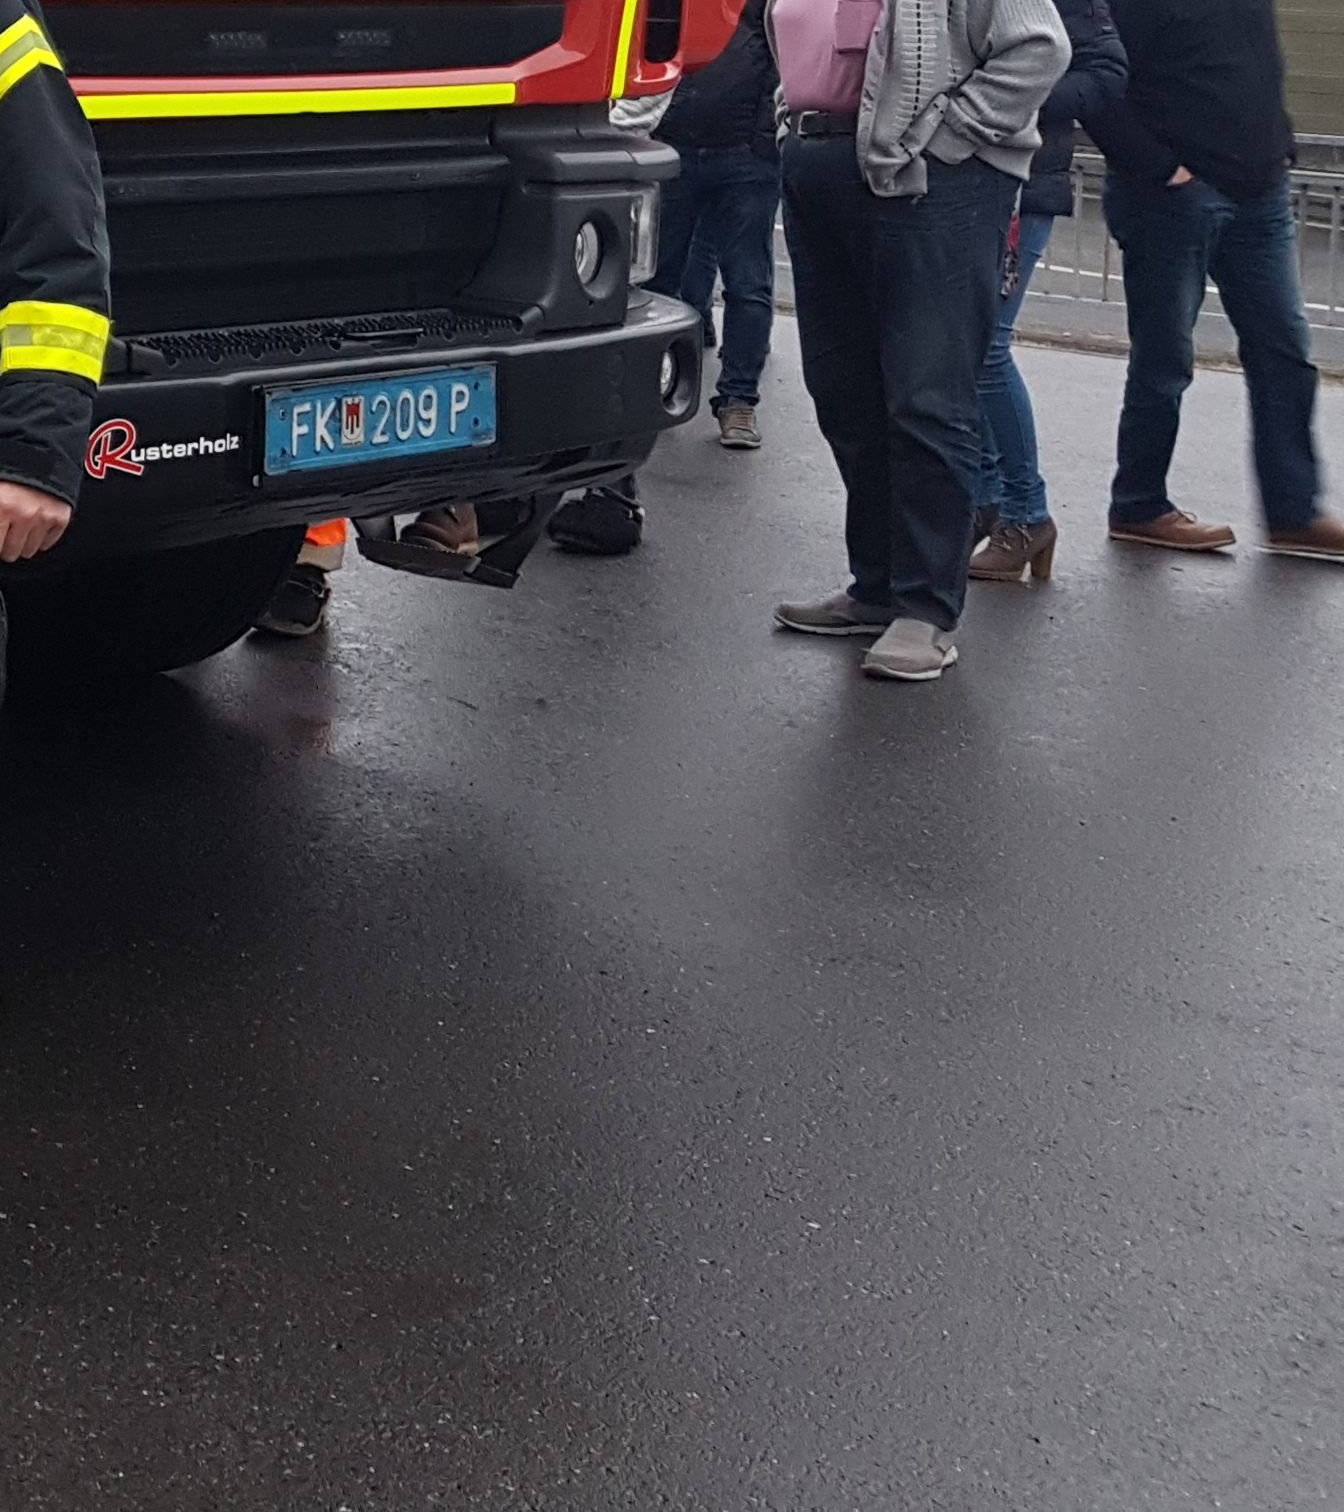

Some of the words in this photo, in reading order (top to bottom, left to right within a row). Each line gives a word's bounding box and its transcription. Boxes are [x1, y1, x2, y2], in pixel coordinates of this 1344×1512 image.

[84, 418, 240, 480] Rusterholz
[291, 402, 336, 458] FK
[369, 387, 438, 445] 209
[448, 383, 471, 434] P
